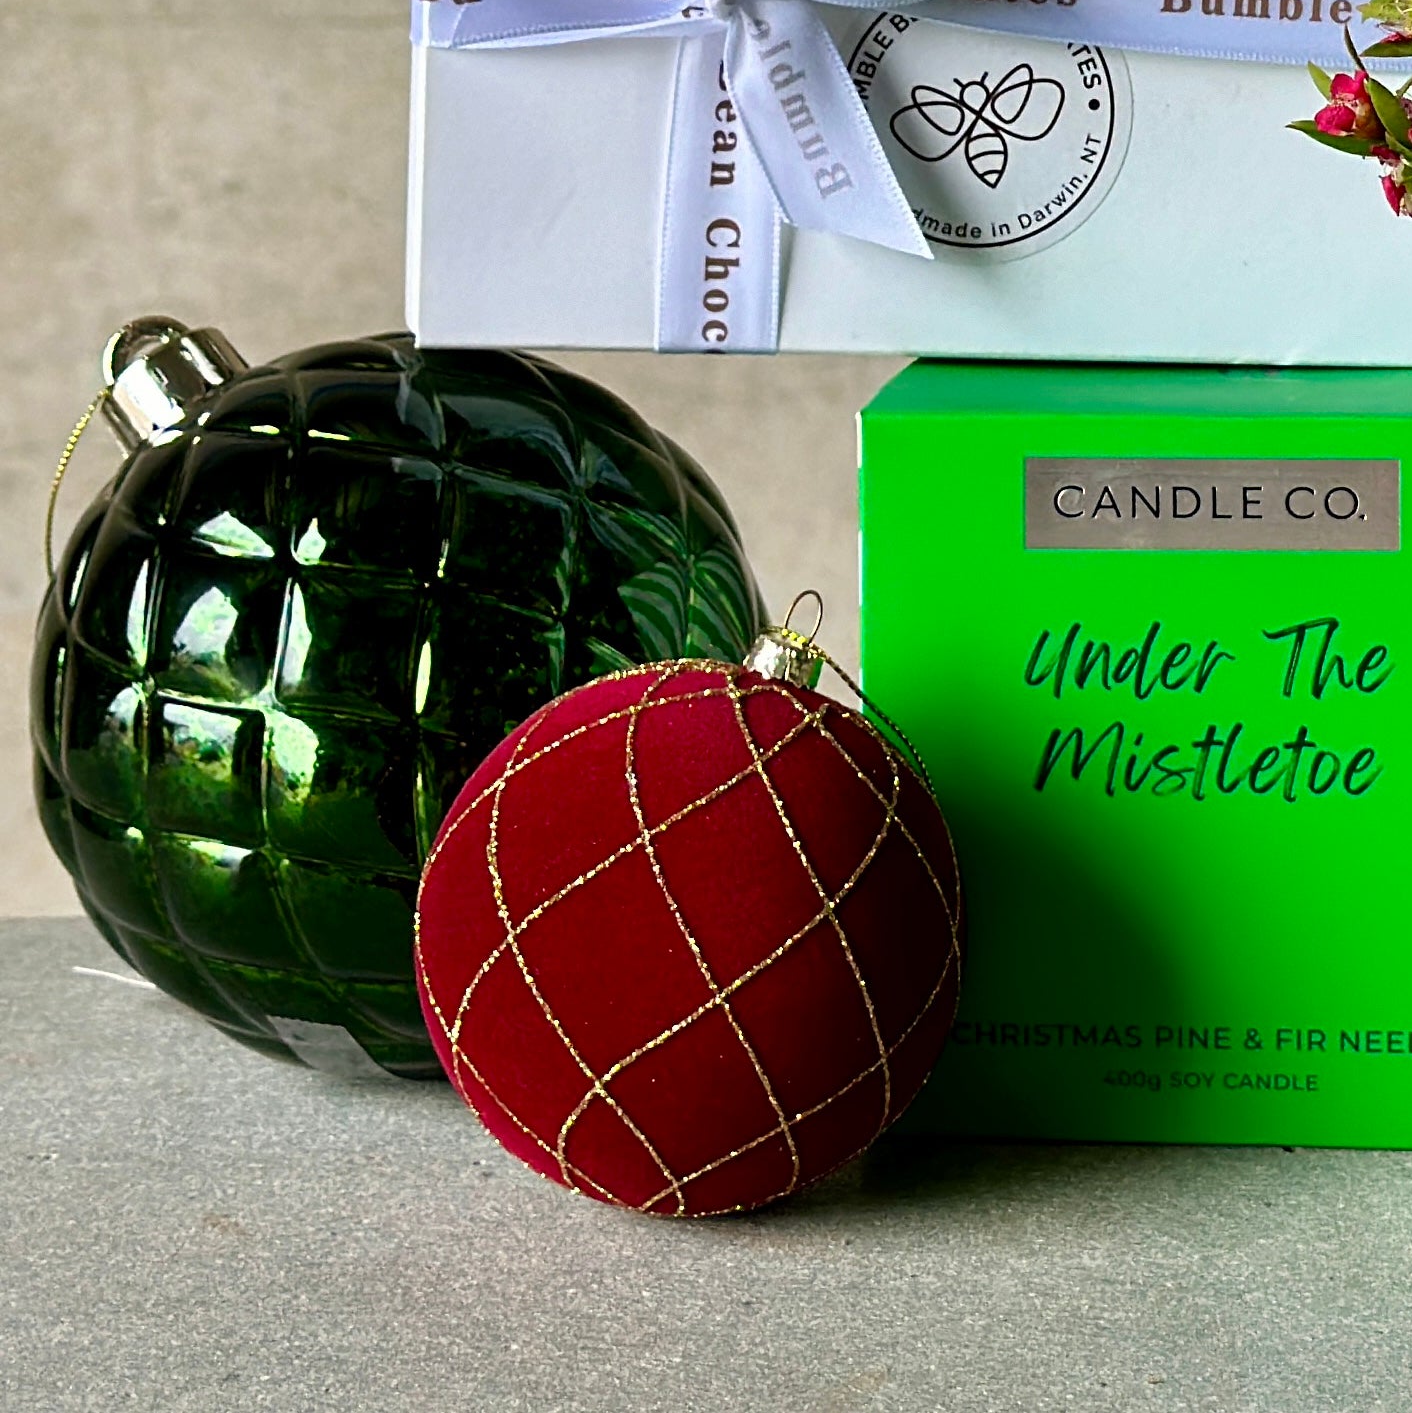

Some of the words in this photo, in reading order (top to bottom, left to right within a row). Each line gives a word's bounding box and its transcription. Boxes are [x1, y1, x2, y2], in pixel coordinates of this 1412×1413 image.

[992, 221, 1011, 238] in
[1080, 132, 1102, 164] NT
[1053, 484, 1264, 521] CANDLE
[1284, 485, 1368, 522] CO.
[1024, 621, 1236, 700] Under
[1262, 616, 1397, 700] The
[1034, 722, 1384, 803] Mistletoe
[951, 1021, 1143, 1050] CHRISTMAS
[1155, 1025, 1232, 1051] PINE
[1243, 1026, 1264, 1052] &
[1275, 1027, 1328, 1054] FIR
[1102, 1070, 1163, 1093] 400g
[1169, 1072, 1215, 1090] SOY
[1222, 1072, 1320, 1093] CANDLE
